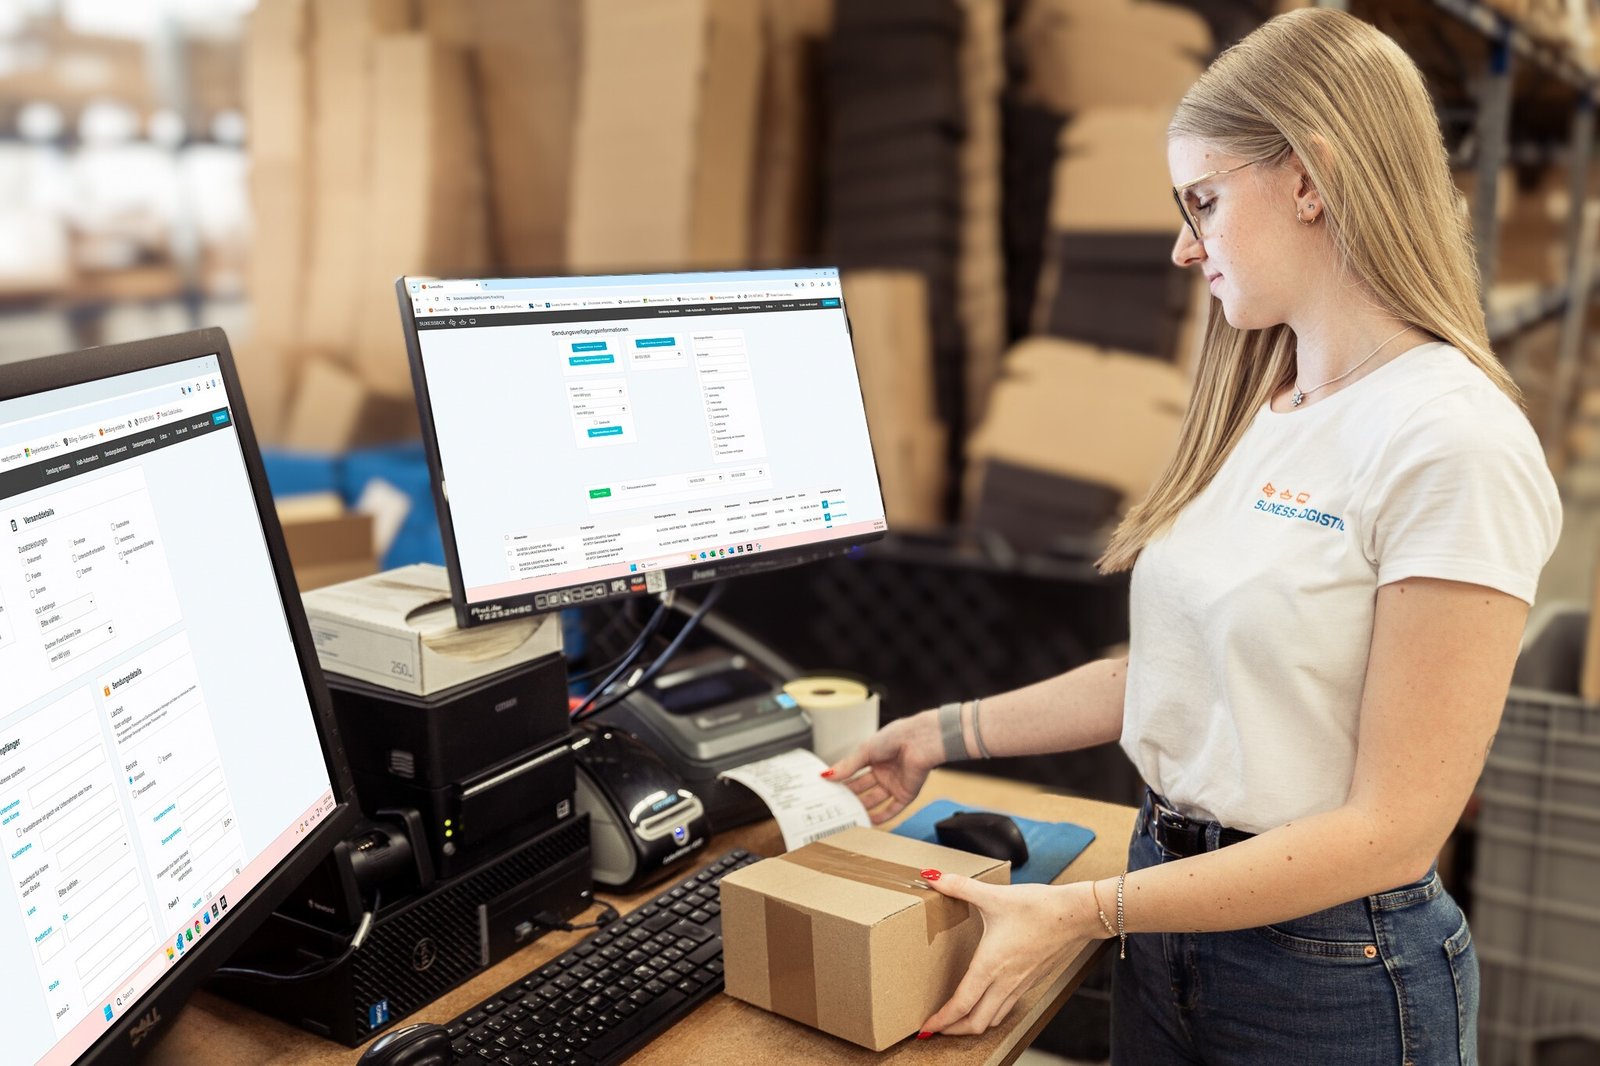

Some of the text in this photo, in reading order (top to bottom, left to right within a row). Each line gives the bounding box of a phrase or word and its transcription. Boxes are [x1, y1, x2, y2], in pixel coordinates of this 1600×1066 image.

[552, 328, 628, 336] Sendungsverfolgungsinformationen
[23, 509, 54, 524] Versanddetails
[1254, 499, 1345, 532] SUXESSOGISTI
[18, 538, 47, 553] Zusatzleistungen
[471, 604, 502, 616] ProLite
[391, 661, 409, 677] 250
[112, 669, 142, 689] Sendungsdetails
[111, 706, 123, 718] Laufzeit
[126, 760, 137, 772] Service
[123, 988, 134, 1001] Search
[129, 1007, 161, 1047] DELL
